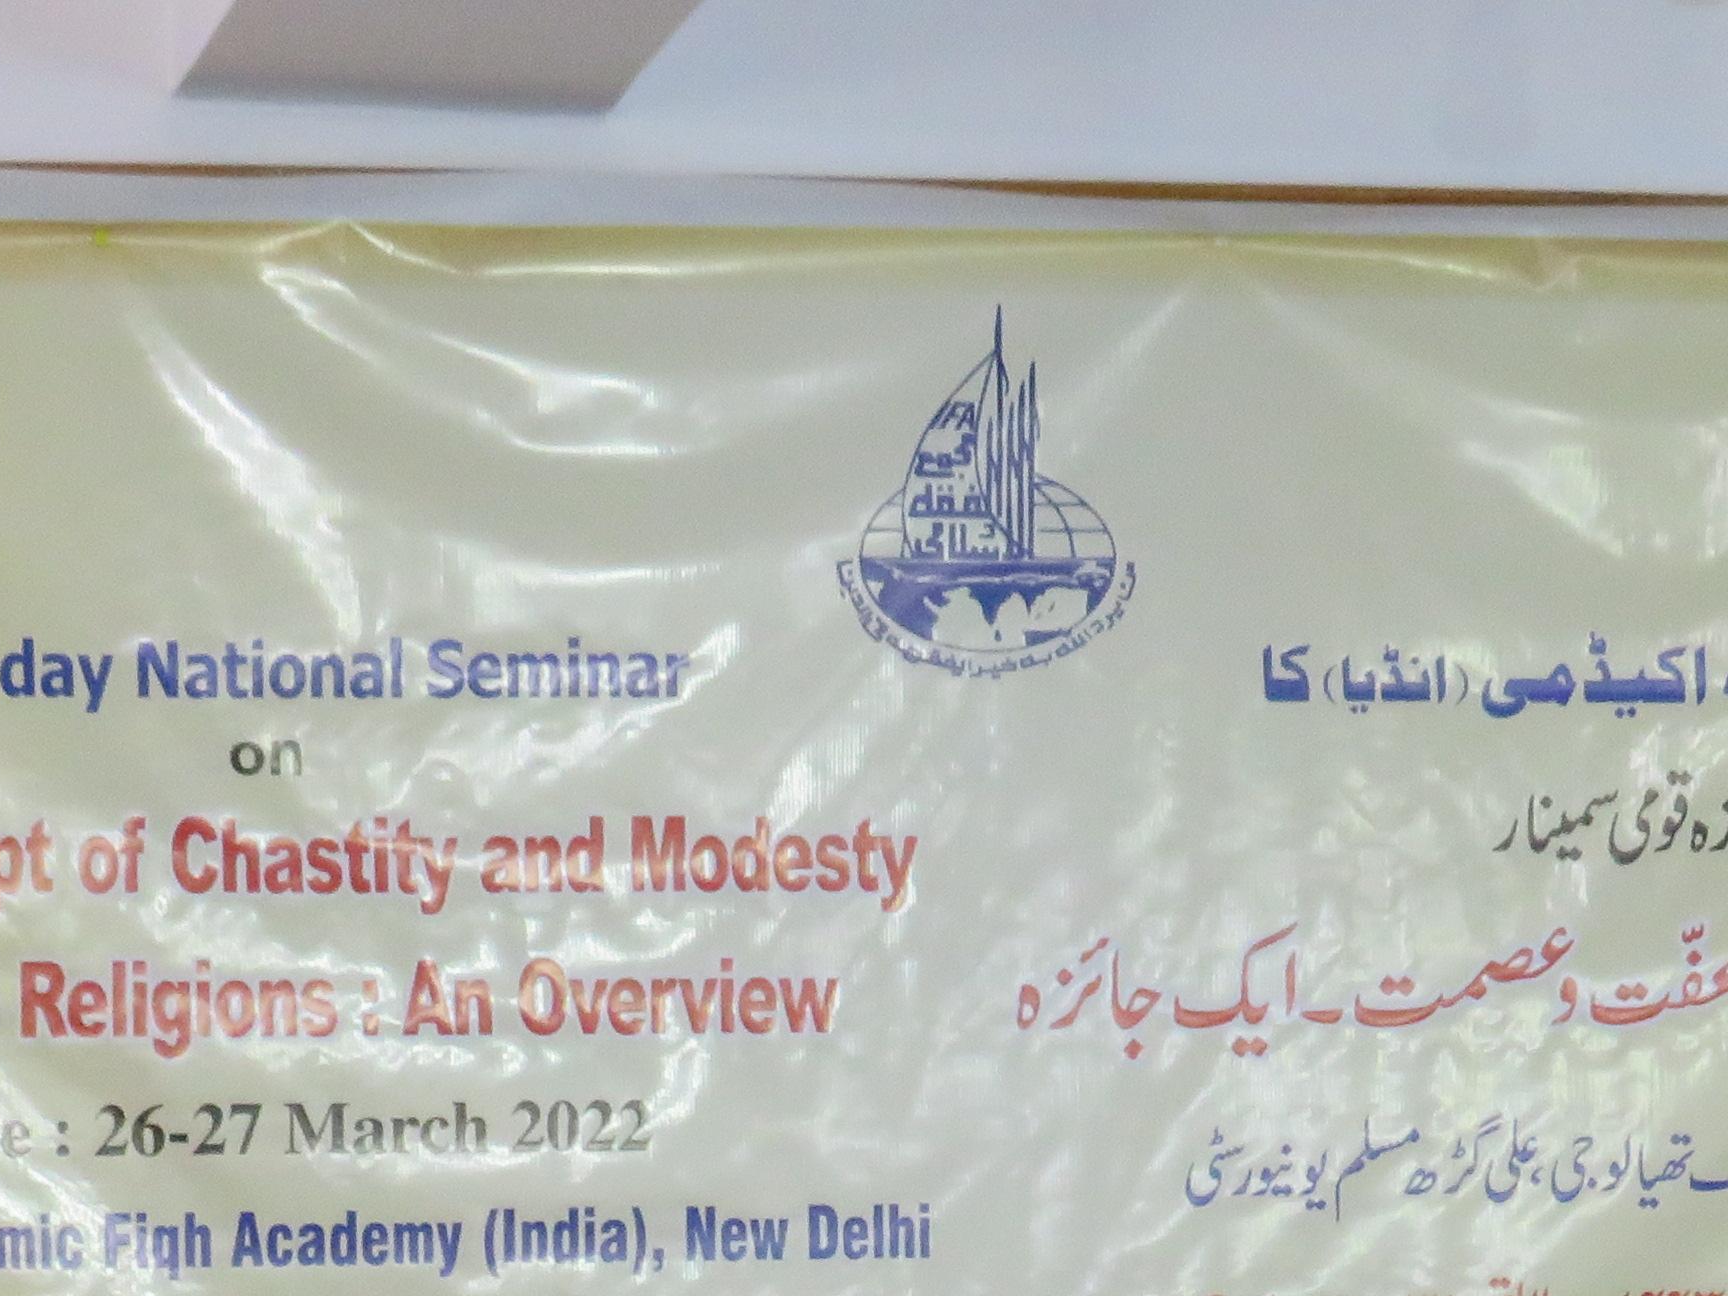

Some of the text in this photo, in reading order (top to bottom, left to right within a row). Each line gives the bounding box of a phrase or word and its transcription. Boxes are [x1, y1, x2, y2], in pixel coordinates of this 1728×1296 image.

[138, 637, 404, 700] National
[427, 638, 691, 699] Seminar
[1262, 643, 1312, 703] کا
[1322, 643, 1469, 714] (انڈیا)
[1480, 632, 1707, 718] اکیڈمی
[229, 732, 304, 777] on
[1491, 789, 1620, 861] سمینار
[1608, 769, 1693, 866] قومی
[79, 816, 147, 895] of
[172, 815, 458, 915] Chastity
[479, 815, 605, 894] and
[630, 815, 919, 913] Modesty
[19, 959, 340, 1060] Religions
[402, 959, 494, 1036] An
[518, 957, 840, 1036] Overview
[1016, 936, 1164, 1060] جائزہ
[1174, 921, 1299, 1058] ایک
[1551, 976, 1578, 1026] و
[93, 1103, 263, 1158] 26-27
[284, 1100, 488, 1156] March
[511, 1099, 654, 1154] 2022
[1184, 1126, 1328, 1208] یونیورسٹی
[1335, 1116, 1422, 1222] مسلم
[103, 1211, 213, 1280] Fiqh
[232, 1210, 463, 1277] Academy
[483, 1206, 666, 1277] (India),
[685, 1205, 789, 1262] New
[808, 1202, 932, 1260] Delhi
